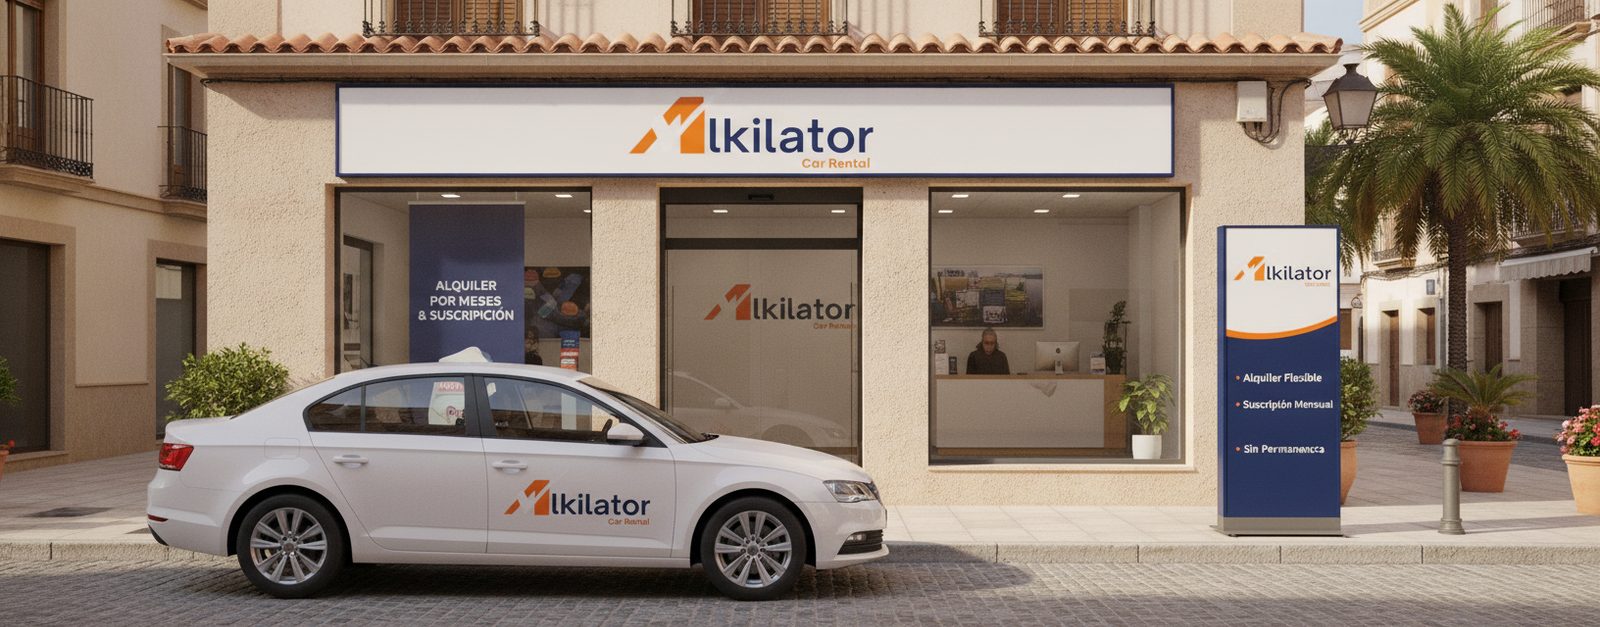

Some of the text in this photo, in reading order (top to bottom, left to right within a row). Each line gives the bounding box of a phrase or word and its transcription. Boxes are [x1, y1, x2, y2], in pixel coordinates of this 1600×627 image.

[801, 157, 871, 169] Car Rental
[435, 280, 497, 293] ALQUILER
[429, 295, 502, 307] POR MESES
[418, 310, 427, 321] &
[1294, 400, 1334, 409] Mensual
[1243, 444, 1259, 454] Sin
